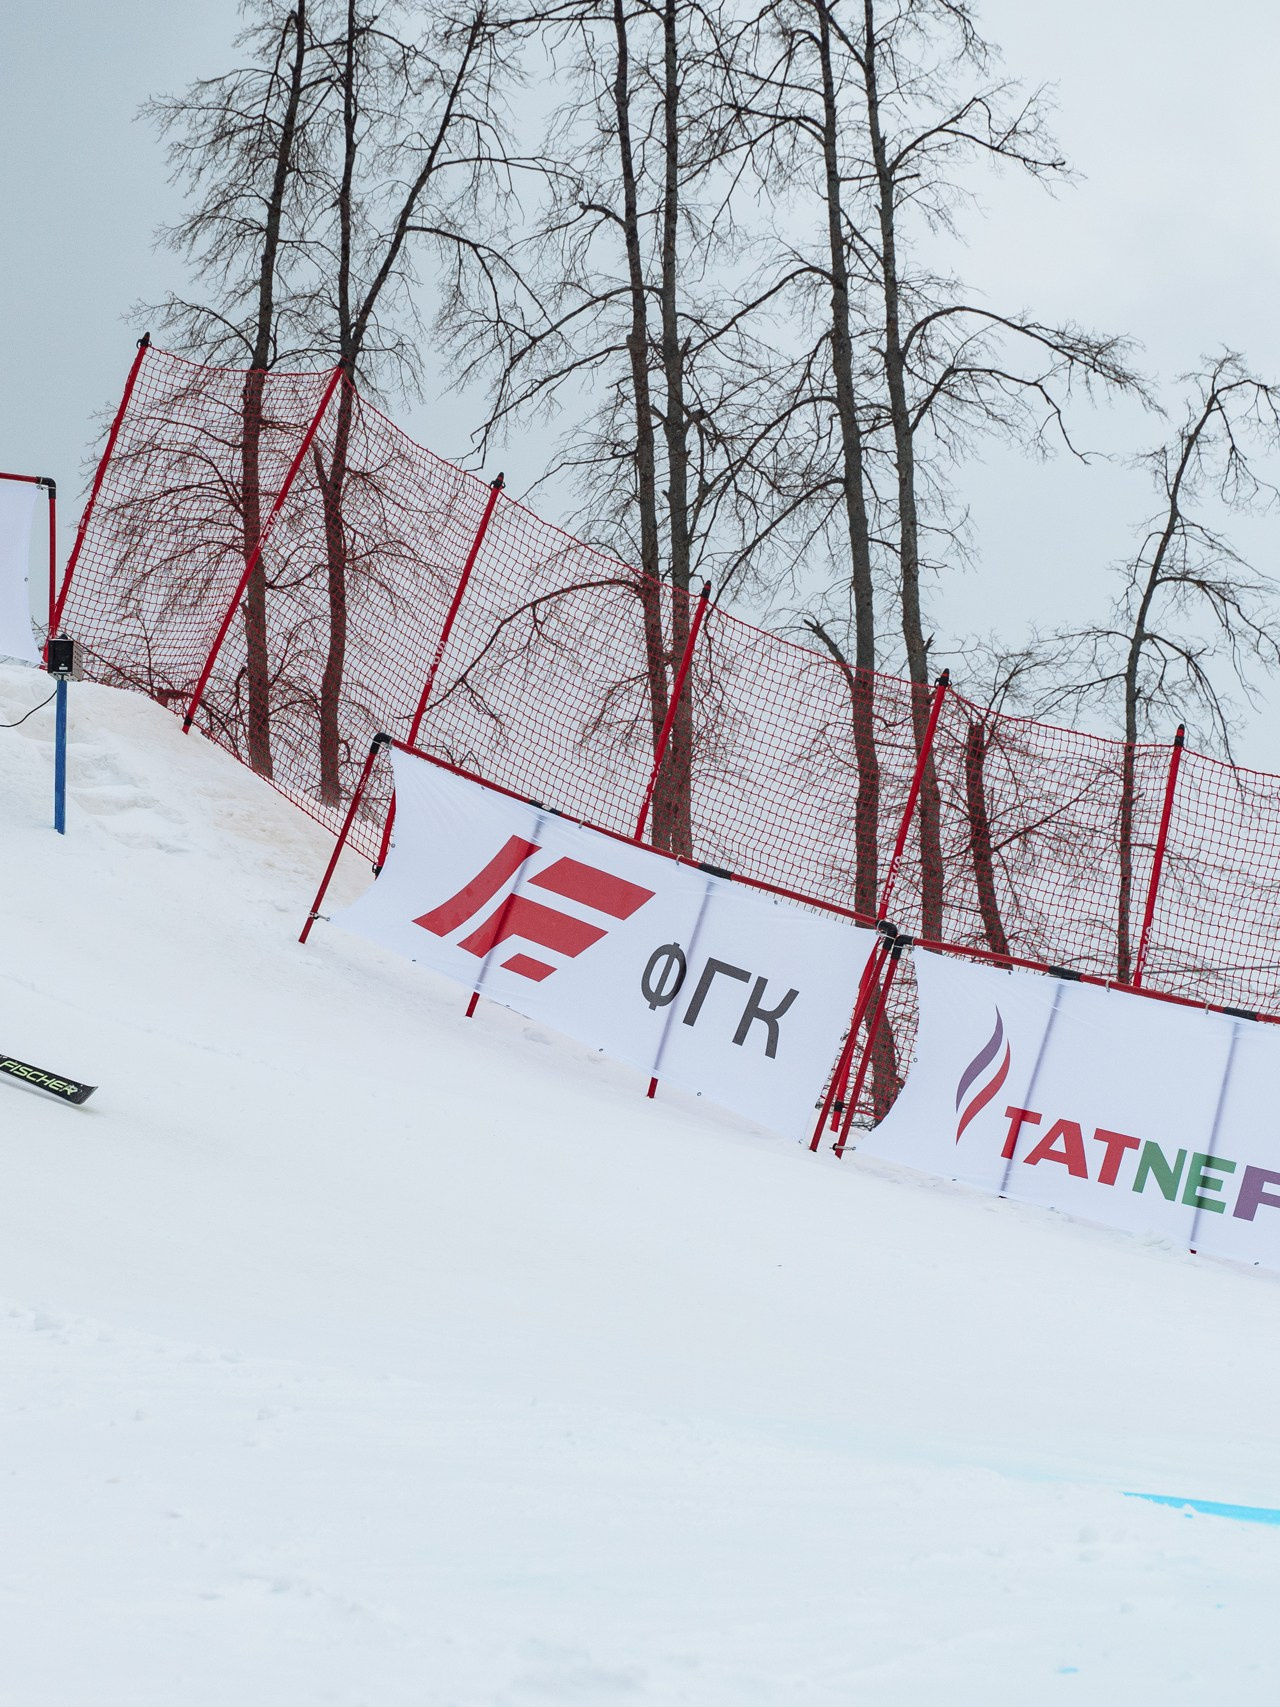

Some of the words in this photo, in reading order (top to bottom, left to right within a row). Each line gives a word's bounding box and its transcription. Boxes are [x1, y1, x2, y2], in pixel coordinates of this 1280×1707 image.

[641, 942, 800, 1060] ФГК
[0, 1060, 78, 1096] FISCHER
[1000, 1105, 1280, 1222] TATNEF
